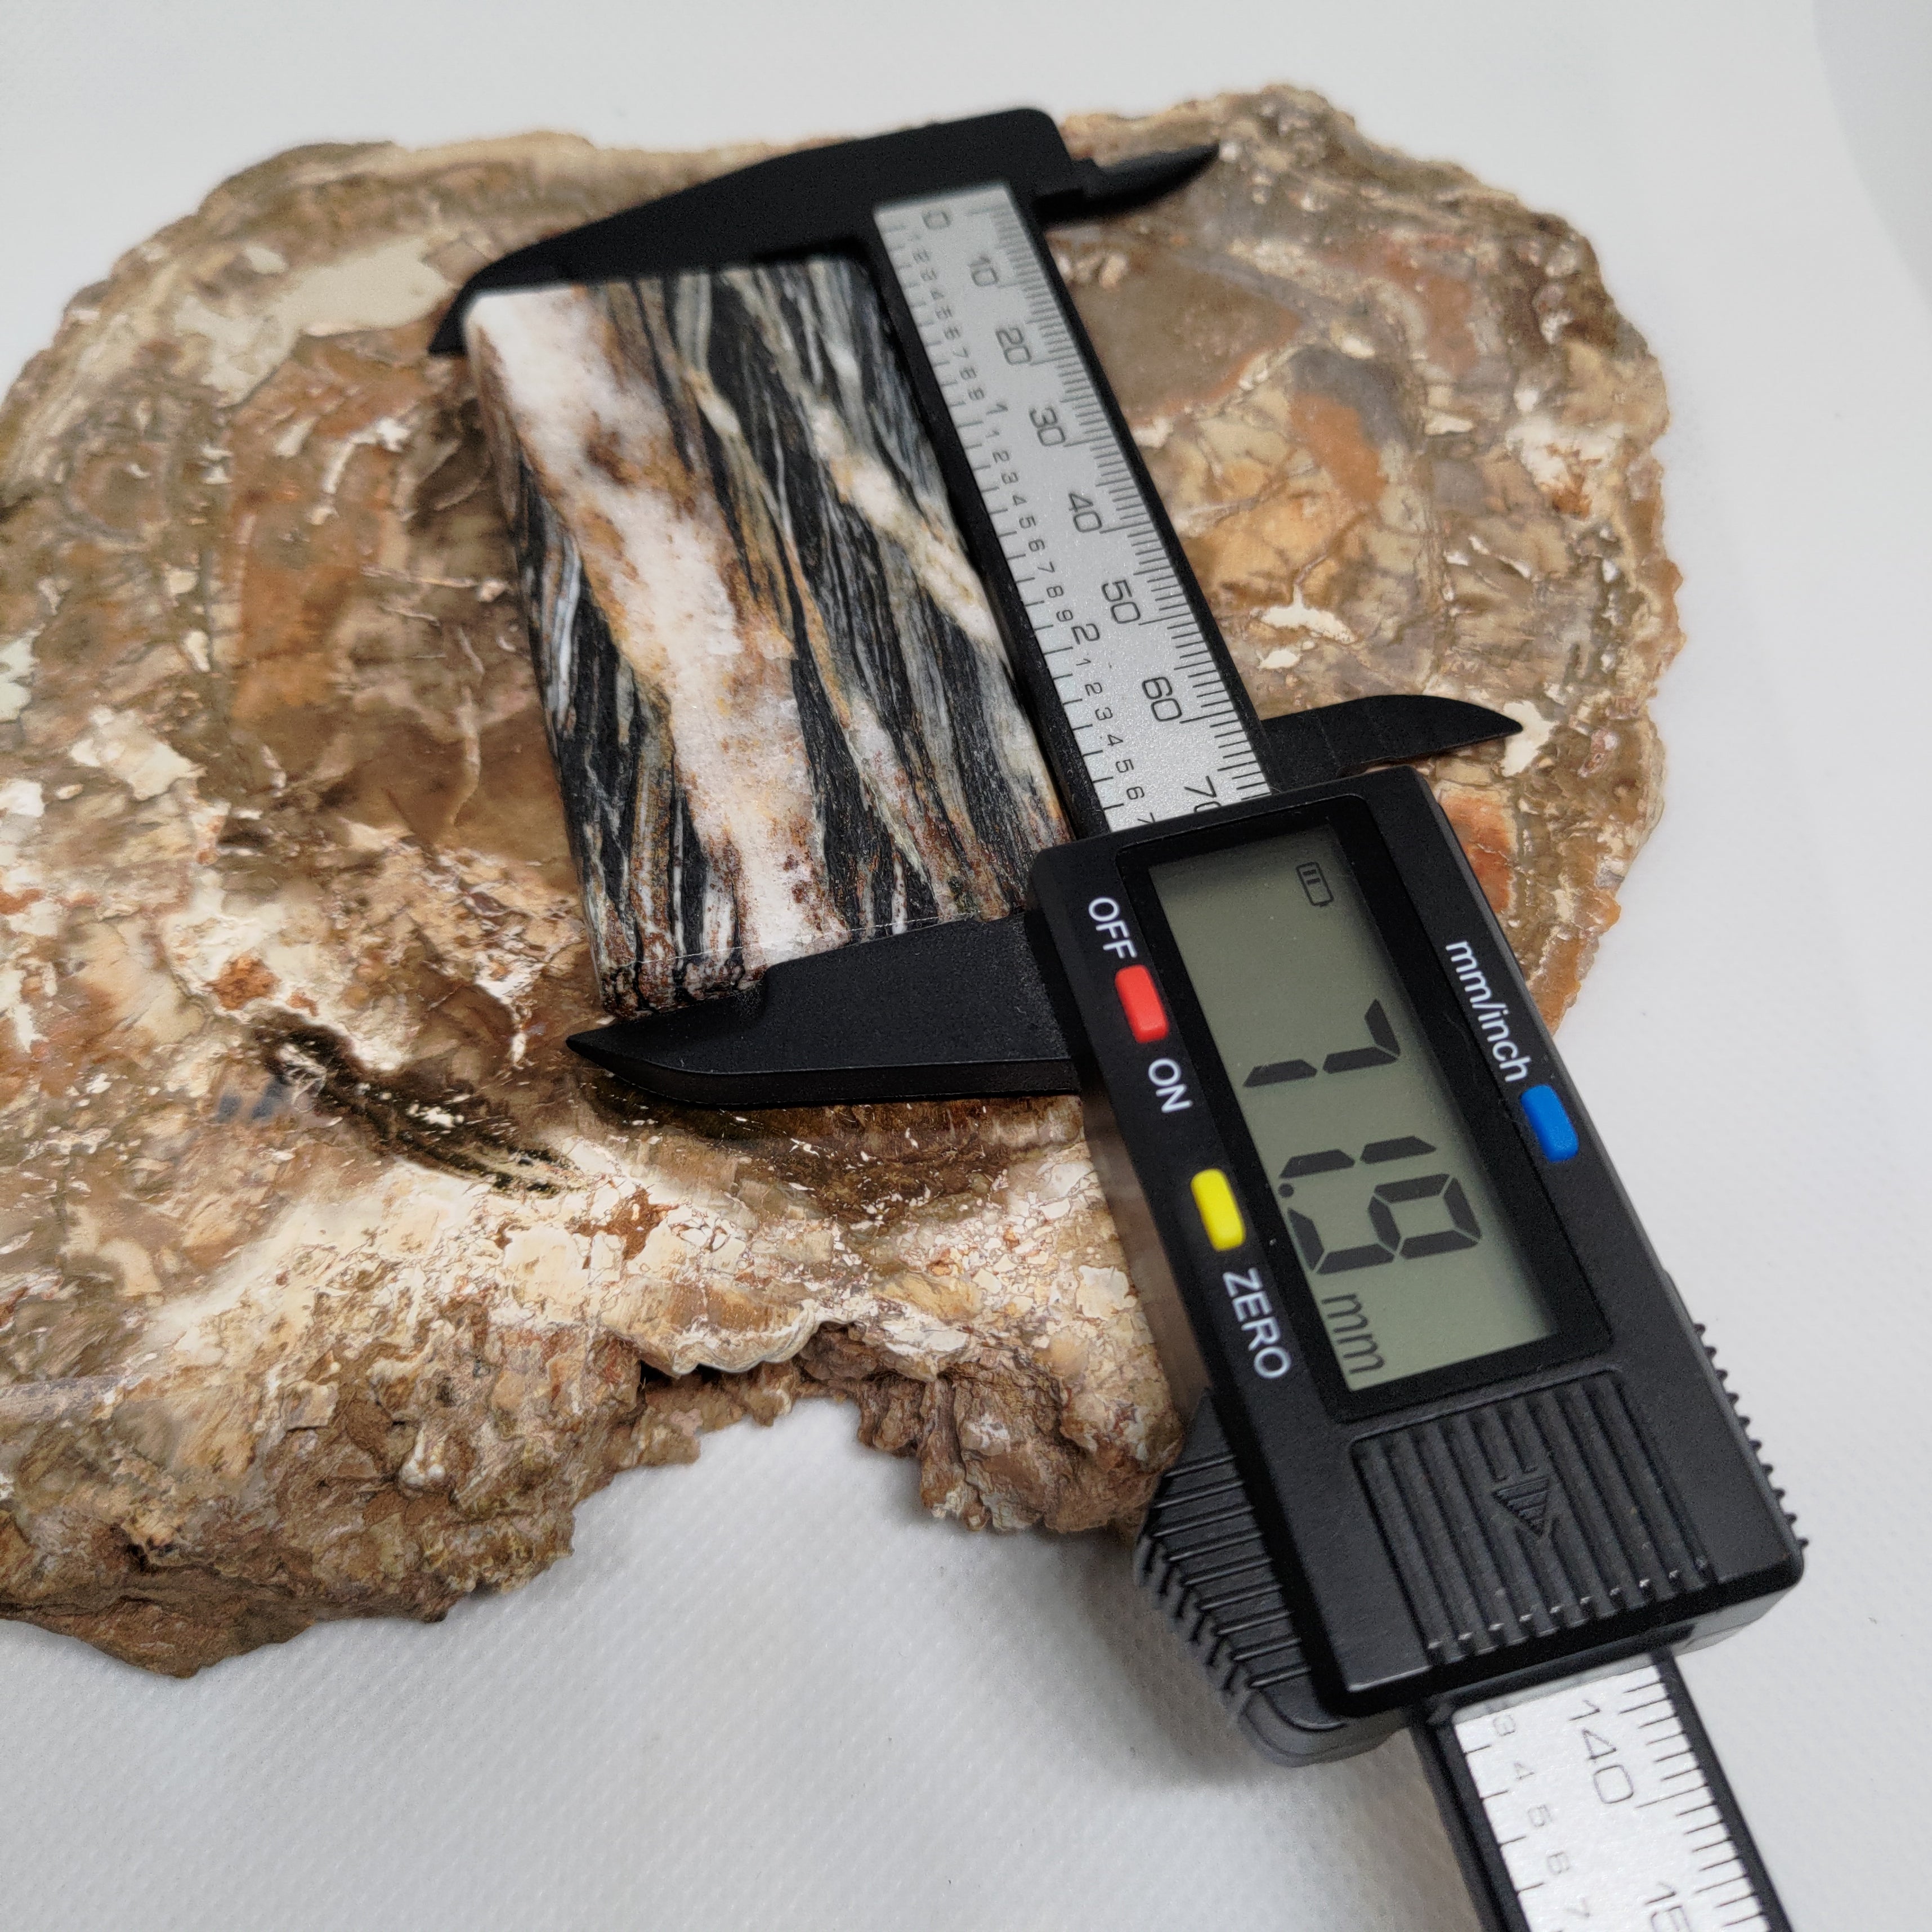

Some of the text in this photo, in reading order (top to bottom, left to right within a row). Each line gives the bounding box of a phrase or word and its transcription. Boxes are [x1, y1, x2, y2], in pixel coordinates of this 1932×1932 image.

[952, 347, 969, 358] 7
[986, 402, 1009, 415] 1
[992, 450, 1010, 464] 2
[922, 211, 951, 230] 0
[968, 254, 999, 287] 10
[995, 325, 1031, 365] 20
[1029, 406, 1066, 446] 30
[1068, 493, 1102, 533] 40
[1102, 579, 1141, 624] 50
[1142, 677, 1182, 722] 60
[1001, 472, 1019, 485] 3
[1013, 495, 1027, 506] 4
[1019, 516, 1036, 529] 5
[1028, 539, 1045, 552] 6
[1037, 561, 1055, 573] 7
[1046, 585, 1064, 598] 8
[1056, 610, 1074, 622] 9
[1071, 623, 1100, 645] 2
[1076, 658, 1092, 667] 1
[1085, 682, 1103, 696] 2
[1095, 706, 1113, 721] 3
[1107, 734, 1123, 746] 4
[1115, 759, 1134, 773] 5
[1126, 786, 1145, 800] 6
[1088, 896, 1137, 959] OFF
[1445, 940, 1532, 1083] mm/inch
[1148, 1058, 1192, 1113] ON
[1223, 1267, 1291, 1379] ZERO
[1321, 1293, 1386, 1375] mm
